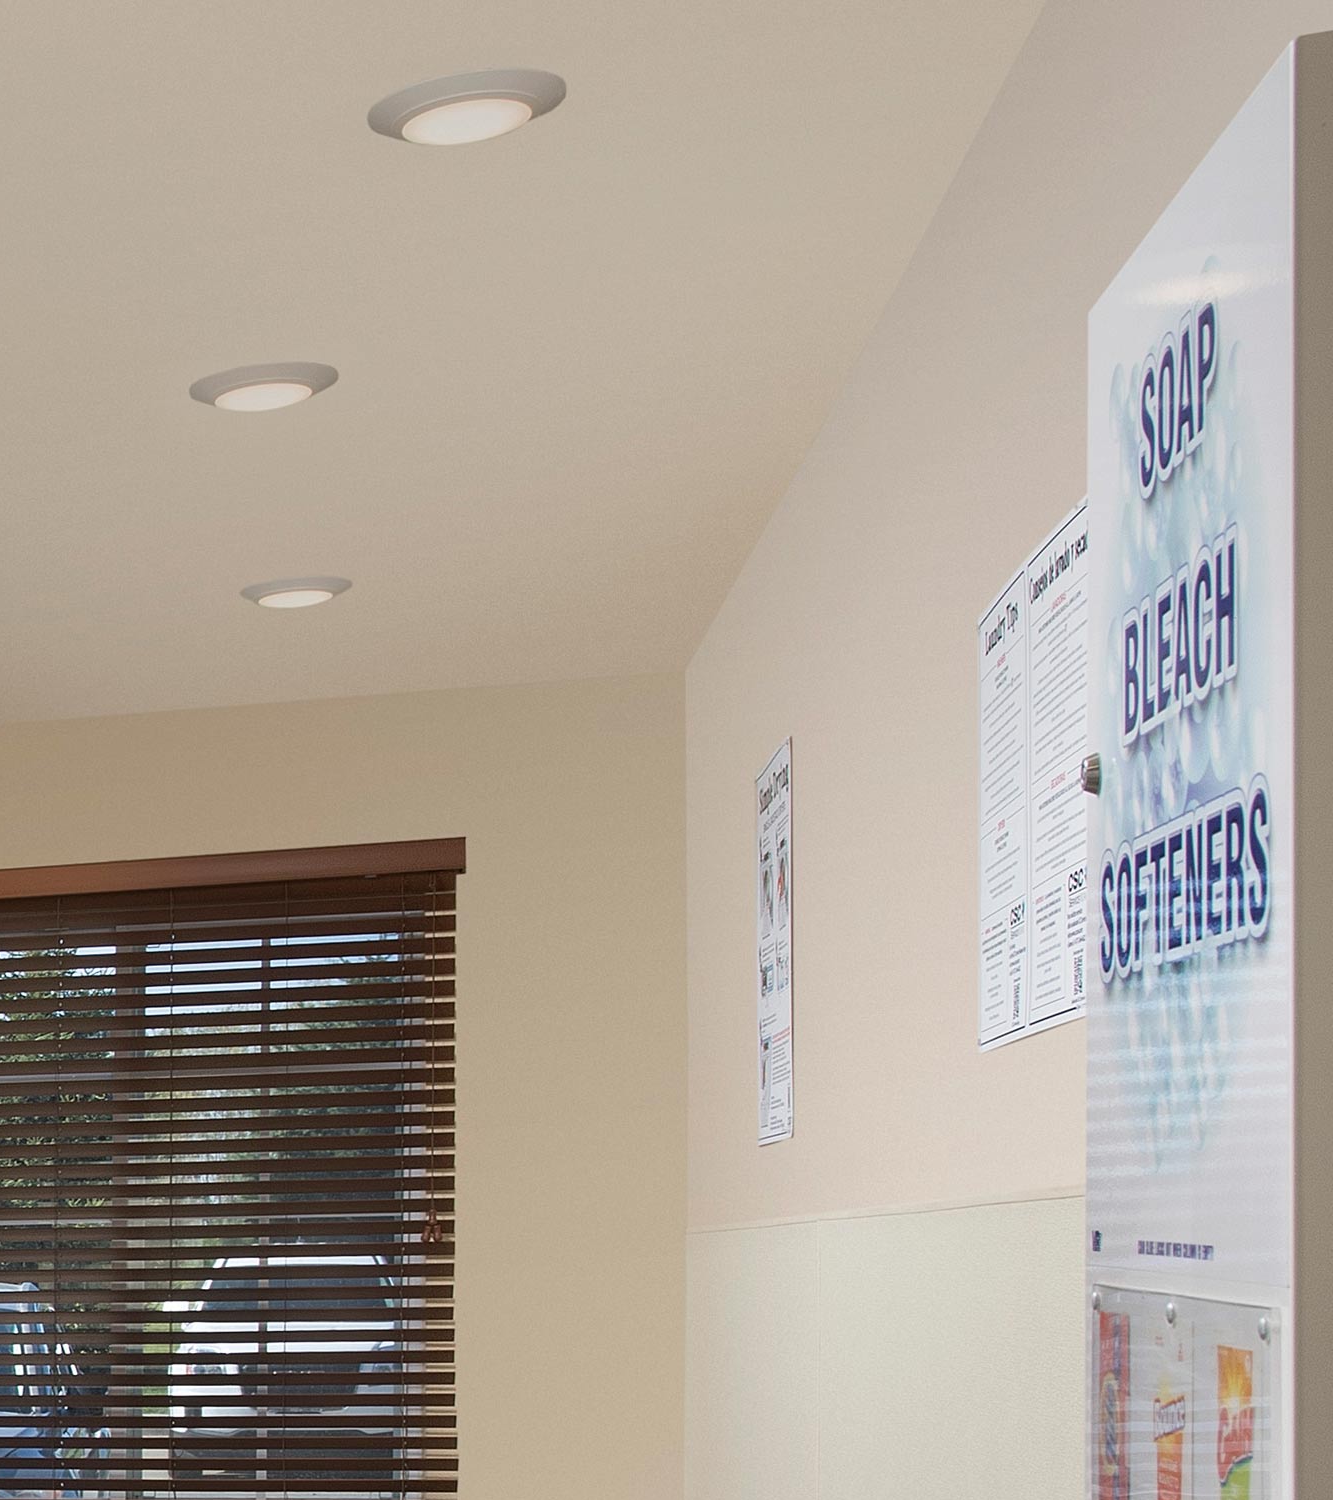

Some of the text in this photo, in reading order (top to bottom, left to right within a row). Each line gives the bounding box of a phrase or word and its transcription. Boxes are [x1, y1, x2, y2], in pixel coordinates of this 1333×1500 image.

[1140, 302, 1217, 490] SOAP
[985, 614, 1006, 657] Laundry
[1006, 602, 1019, 633] Tips
[1123, 537, 1237, 741] BLEACH
[1068, 868, 1083, 892] CSC
[1100, 775, 1270, 975] SOFTENERS
